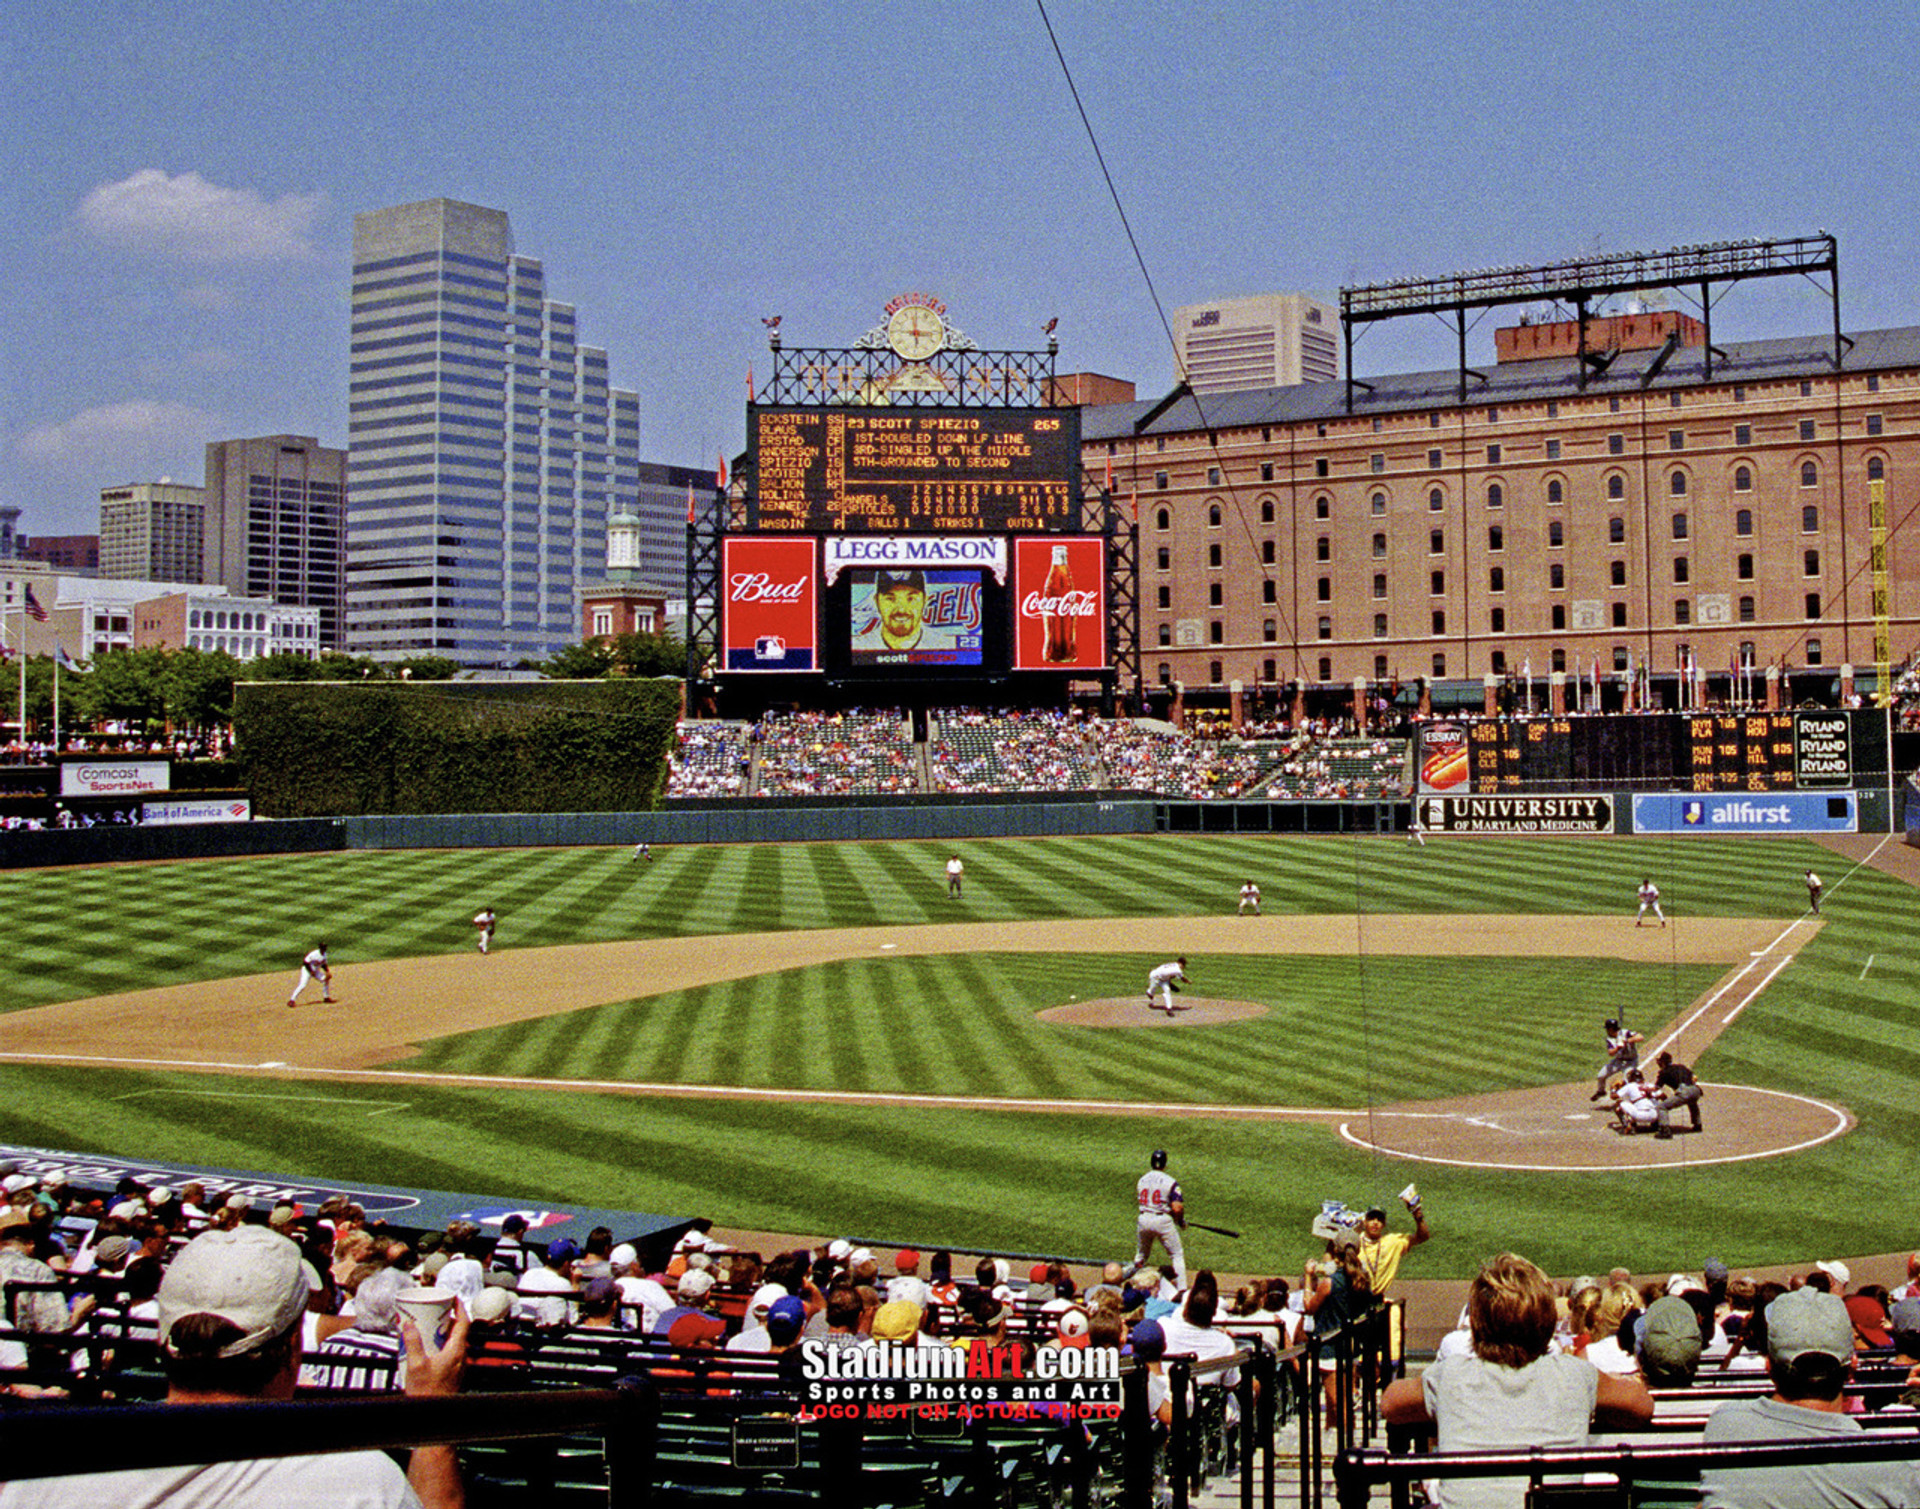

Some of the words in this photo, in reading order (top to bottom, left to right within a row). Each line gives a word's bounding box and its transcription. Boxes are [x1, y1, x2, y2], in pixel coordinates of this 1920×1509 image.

[967, 367, 1030, 393] SUN
[759, 414, 819, 424] ECKSTEIN
[826, 414, 842, 424] SS
[847, 418, 865, 430] 23
[870, 418, 912, 430] SCOTT
[920, 418, 980, 430] SPIEZIO
[1033, 418, 1060, 430] 265
[759, 425, 798, 435] GLAUS
[759, 436, 804, 446] ERSTAD
[826, 436, 842, 446] CF
[855, 433, 932, 444] 1ST-DOUBLED
[938, 433, 968, 444] DOWN
[974, 433, 988, 444] LF
[995, 433, 1024, 444] LINE
[759, 447, 819, 457] ANDERSON
[826, 447, 842, 457] LF
[854, 446, 932, 456] 3RD-SINGLED
[938, 446, 954, 456] UP
[960, 446, 980, 456] THE
[988, 446, 1031, 456] MIDDLE
[759, 458, 812, 468] SPIEZIO
[854, 458, 938, 468] 5TH-GROUNDED
[946, 458, 960, 468] TO
[966, 458, 1010, 468] SECOND
[759, 468, 804, 478] WOOTEN
[826, 468, 842, 478] DH
[759, 479, 804, 489] SALMON
[826, 479, 842, 489] RF
[924, 484, 930, 494] 2
[936, 484, 942, 494] 3
[948, 484, 955, 494] 4
[960, 484, 967, 494] 5
[972, 484, 979, 494] 6
[984, 484, 990, 494] 7
[995, 484, 1002, 494] 8
[1007, 484, 1014, 494] 9
[759, 490, 805, 500] MOLINA
[844, 495, 888, 505] ANGELS
[912, 495, 918, 505] 2
[924, 495, 930, 505] 0
[936, 495, 943, 505] 4
[759, 501, 812, 511] KENNEDY
[844, 504, 896, 515] ORIOLES
[912, 504, 919, 515] 0
[924, 504, 930, 515] 2
[936, 504, 943, 515] 0
[948, 504, 955, 515] 0
[960, 504, 967, 515] 0
[972, 504, 979, 515] 0
[1020, 504, 1027, 515] 2
[1034, 504, 1041, 515] 8
[758, 519, 804, 528] WASDIN
[834, 519, 842, 528] P
[868, 518, 899, 528] BALLS
[904, 518, 910, 528] 1
[933, 518, 974, 528] STRIKES
[978, 518, 984, 528] 1
[1007, 518, 1034, 528] OUTS
[1037, 518, 1044, 528] 1
[834, 542, 898, 559] LEGG
[905, 542, 998, 559] MASON
[730, 572, 808, 602] Bud
[960, 636, 980, 648] 23
[876, 654, 908, 663] scott
[1800, 720, 1846, 734] RYLAND
[1426, 732, 1461, 743] ESSKAY
[1528, 733, 1542, 742] KC
[1692, 728, 1712, 738] FLA
[1748, 744, 1761, 754] LA
[1800, 739, 1846, 752] RYLAND
[1478, 759, 1497, 768] CLE
[1800, 759, 1847, 772] RYLAND
[90, 781, 154, 791] SportsNet
[143, 808, 168, 820] Bank
[170, 807, 182, 818] of
[182, 806, 222, 817] America
[1453, 799, 1597, 817] UNIVERSITY
[1712, 802, 1792, 824] allfirst
[1454, 820, 1469, 831] OF
[1472, 820, 1538, 831] MARYLAND
[1540, 820, 1598, 831] MEDICINE
